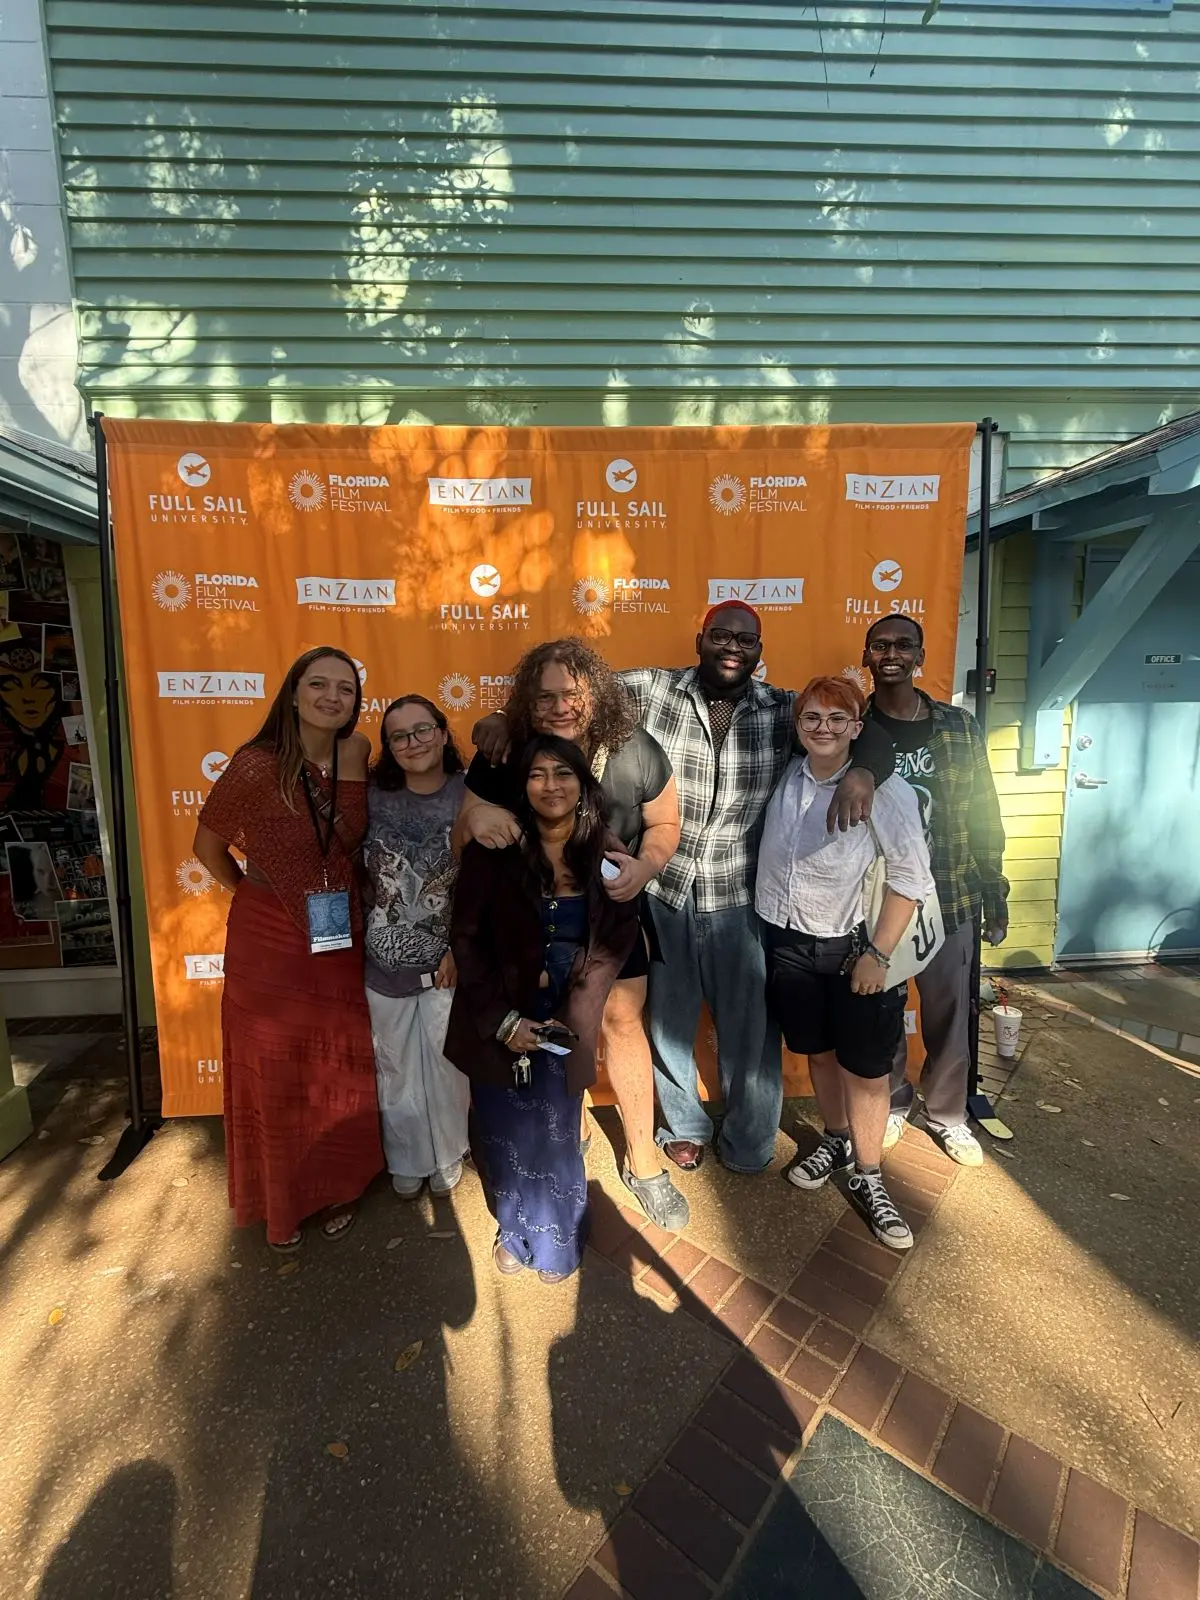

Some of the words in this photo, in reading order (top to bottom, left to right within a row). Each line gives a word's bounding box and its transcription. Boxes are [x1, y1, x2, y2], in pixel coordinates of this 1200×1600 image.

[328, 474, 390, 488] FLORIDA
[750, 476, 808, 488] FLORIDA
[330, 487, 360, 499] FILM
[438, 482, 525, 501] ENZIAN
[750, 489, 778, 500] FILM
[853, 480, 935, 499] ENZIAN
[149, 494, 196, 512] FULL
[203, 495, 248, 514] SAIL
[331, 500, 392, 512] FESTIVAL
[576, 501, 620, 517] FULL
[627, 501, 667, 518] SAIL
[750, 501, 808, 512] FESTIVAL
[876, 503, 895, 511] FOOD
[195, 573, 259, 588] FLORIDA
[613, 578, 670, 590] FLORIDA
[196, 586, 226, 597] FILM
[304, 582, 389, 601] ENZIAN
[613, 590, 642, 601] FILM
[716, 583, 797, 601] ENZIAN
[196, 598, 261, 612] FESTIVAL
[440, 604, 485, 620] FULL
[491, 603, 530, 619] SAIL
[613, 602, 671, 614] FESTIVAL
[846, 598, 882, 614] FULL
[889, 599, 926, 614] SAIL
[1150, 655, 1176, 663] OFFICE
[167, 675, 257, 694] ENZIAN
[480, 687, 507, 698] FILM
[480, 698, 508, 709] FEST
[171, 790, 210, 806] FUL
[197, 1059, 219, 1074] FU
